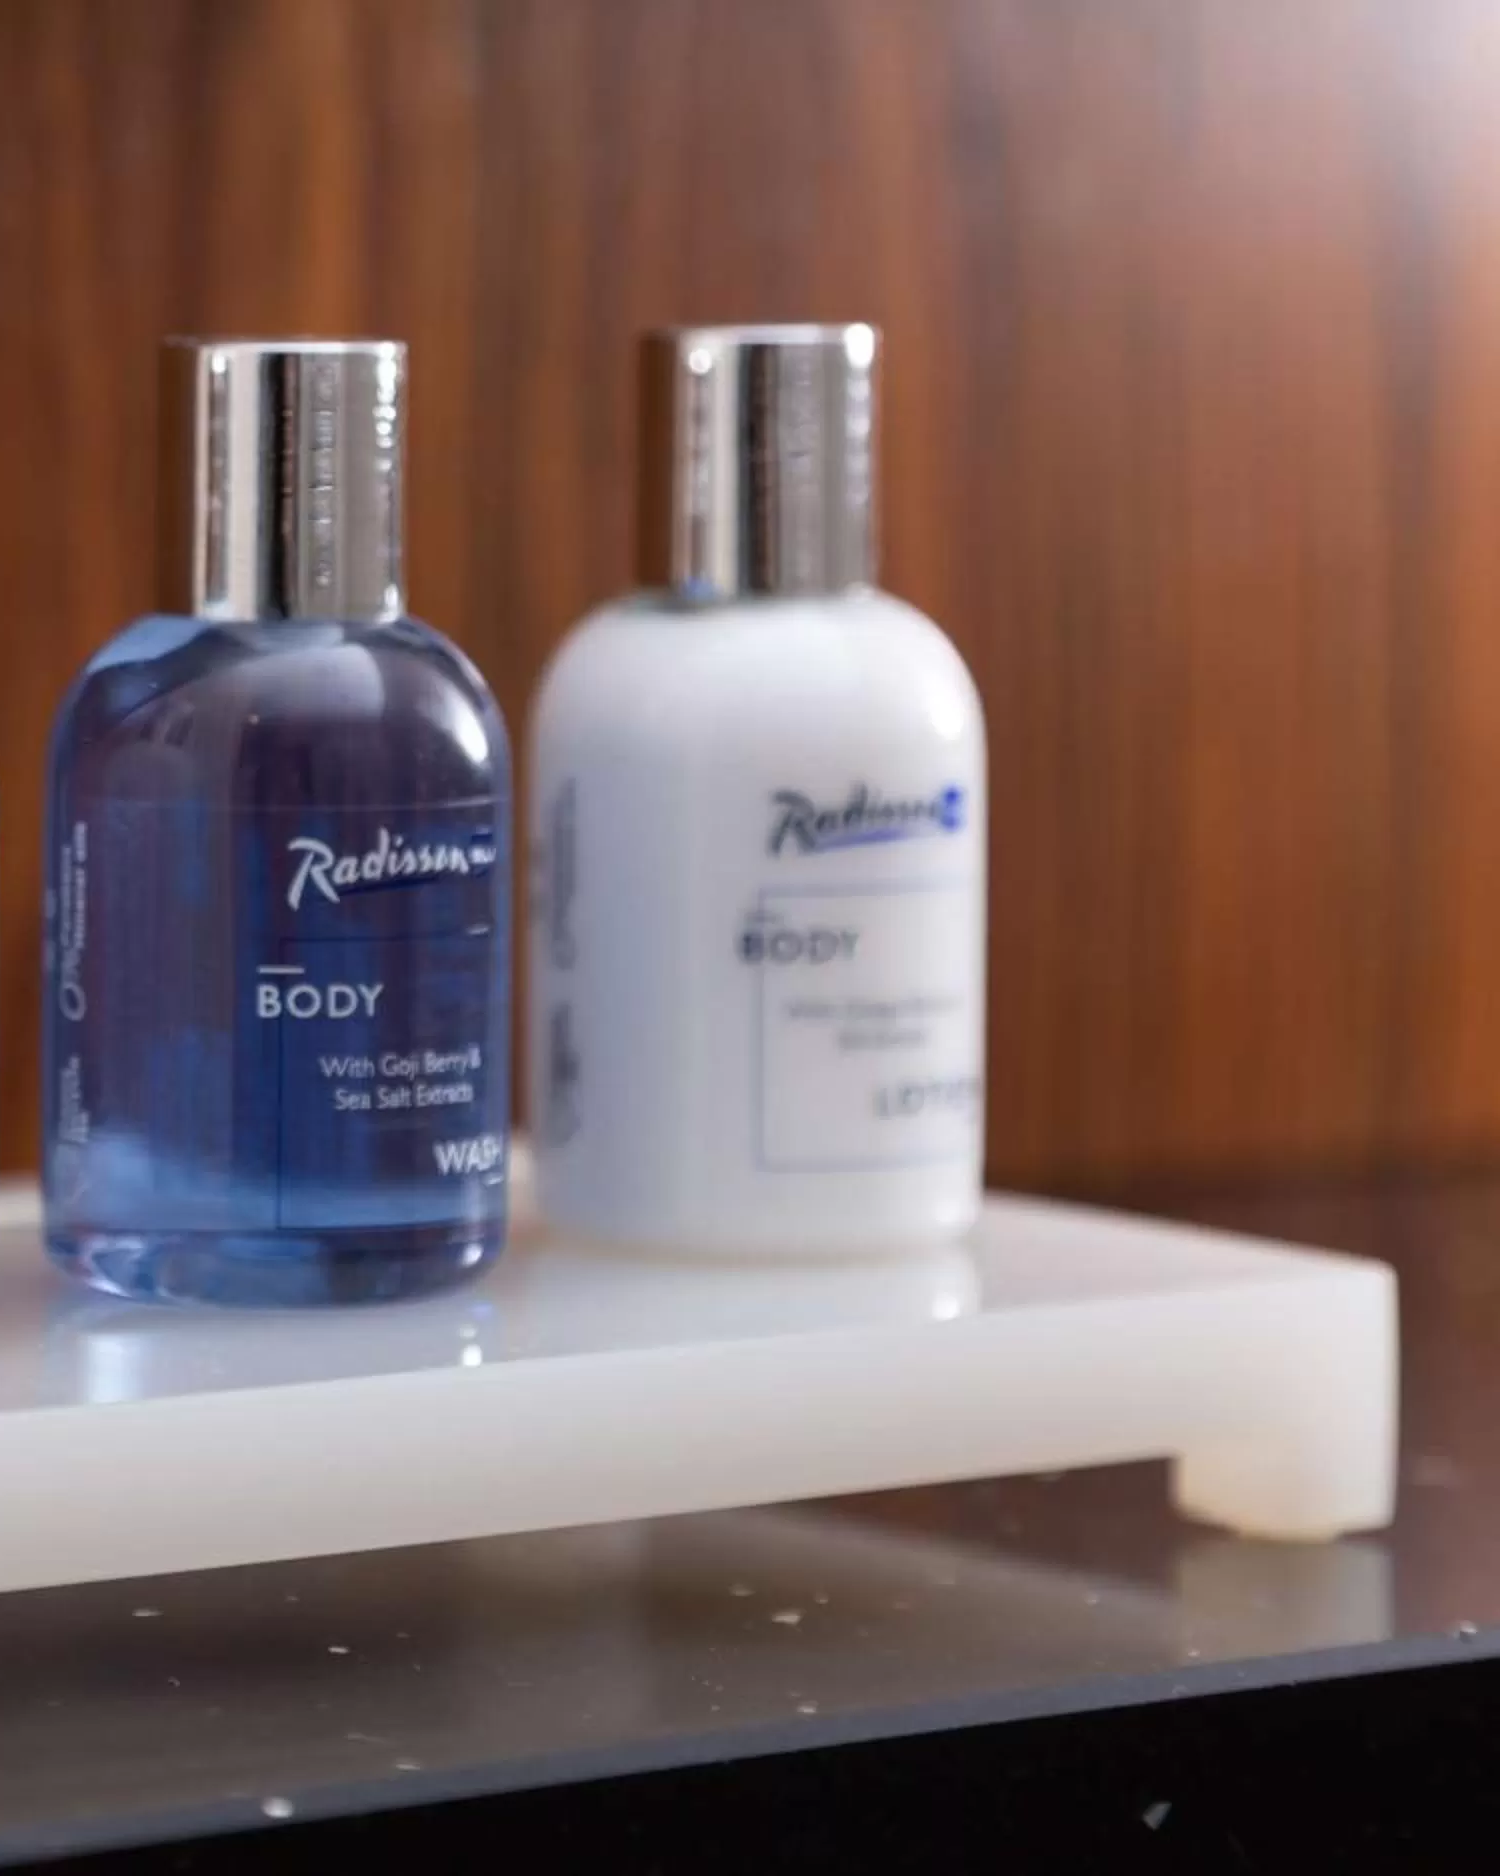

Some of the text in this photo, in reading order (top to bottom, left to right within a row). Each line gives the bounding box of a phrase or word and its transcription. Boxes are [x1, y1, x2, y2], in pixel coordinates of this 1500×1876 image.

[287, 826, 469, 911] Radisson
[741, 929, 860, 967] BODY
[256, 983, 384, 1019] BODY
[319, 1055, 376, 1079] With
[380, 1052, 419, 1081] Goji
[334, 1088, 372, 1111] Sea
[376, 1085, 412, 1109] Salt
